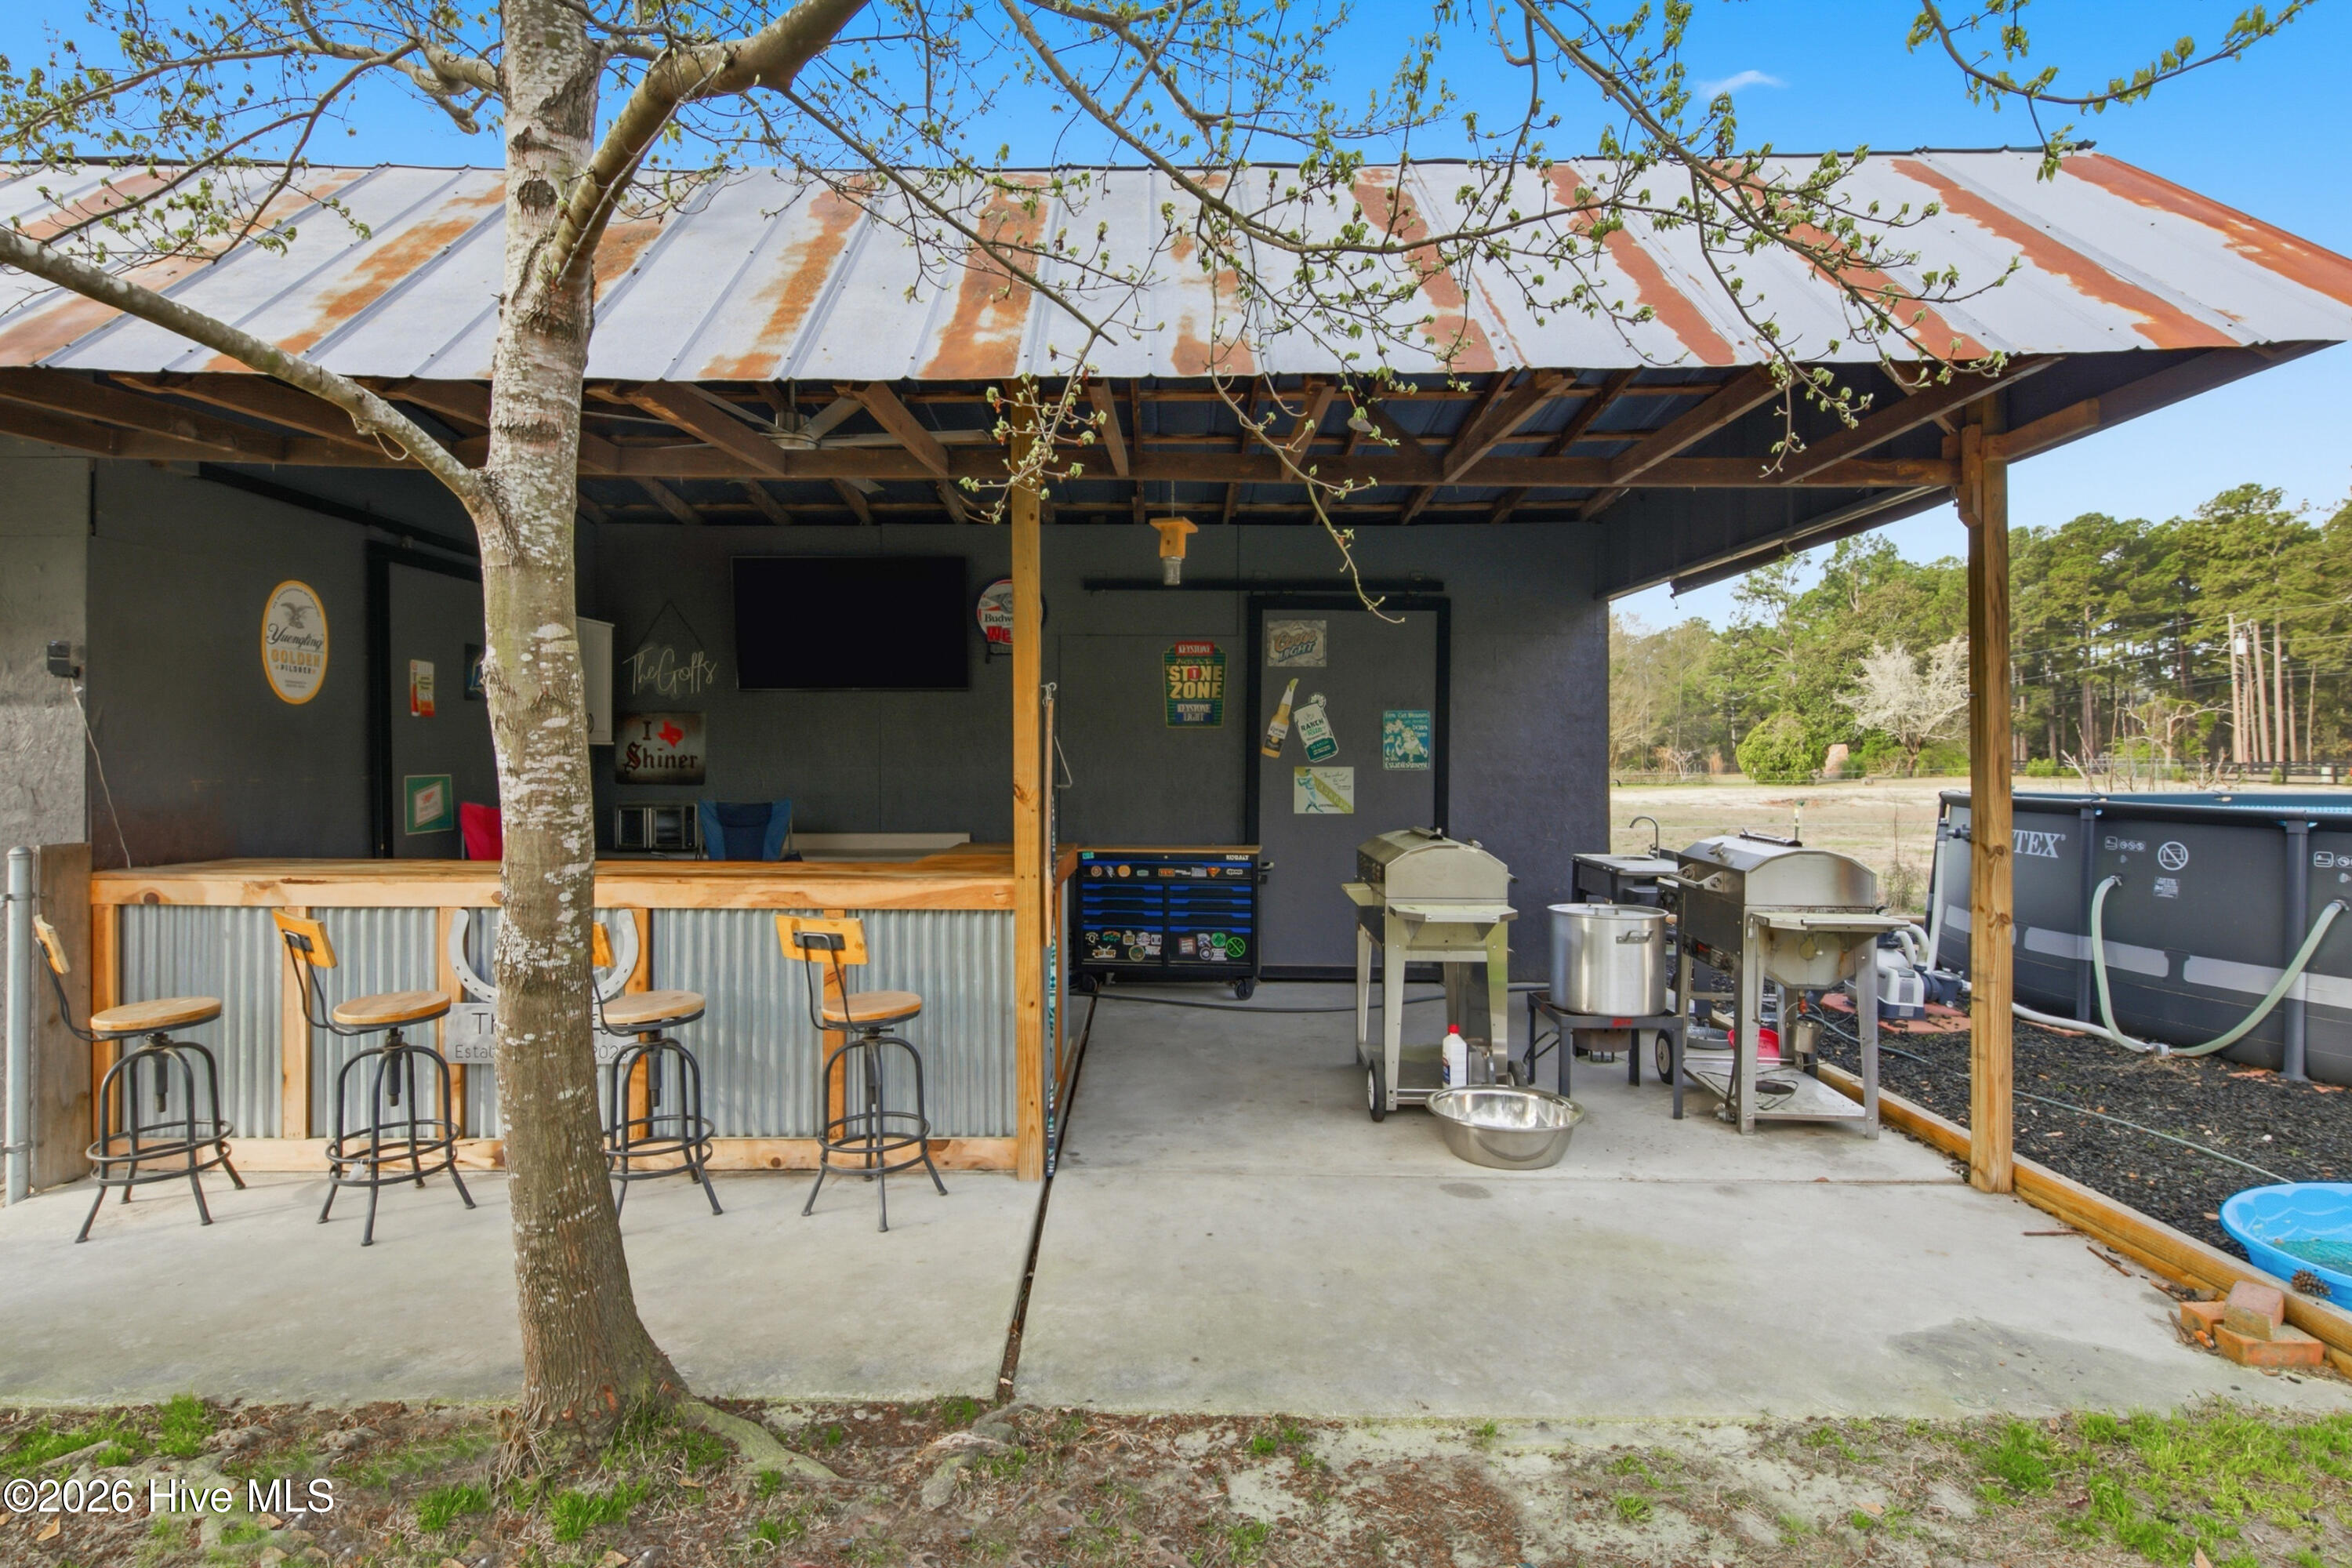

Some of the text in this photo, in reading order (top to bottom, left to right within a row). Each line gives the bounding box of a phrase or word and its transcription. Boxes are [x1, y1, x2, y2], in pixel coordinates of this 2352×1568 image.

[267, 623, 323, 651] Yuengling
[271, 649, 320, 667] GOLDEN
[1178, 644, 1211, 654] KEYSTONE
[622, 647, 658, 695] The
[1170, 681, 1223, 699] ZONE
[1177, 704, 1211, 713] KEYSTONE
[642, 720, 652, 741] I
[622, 742, 699, 774] Shiner
[2013, 829, 2061, 858] TEX
